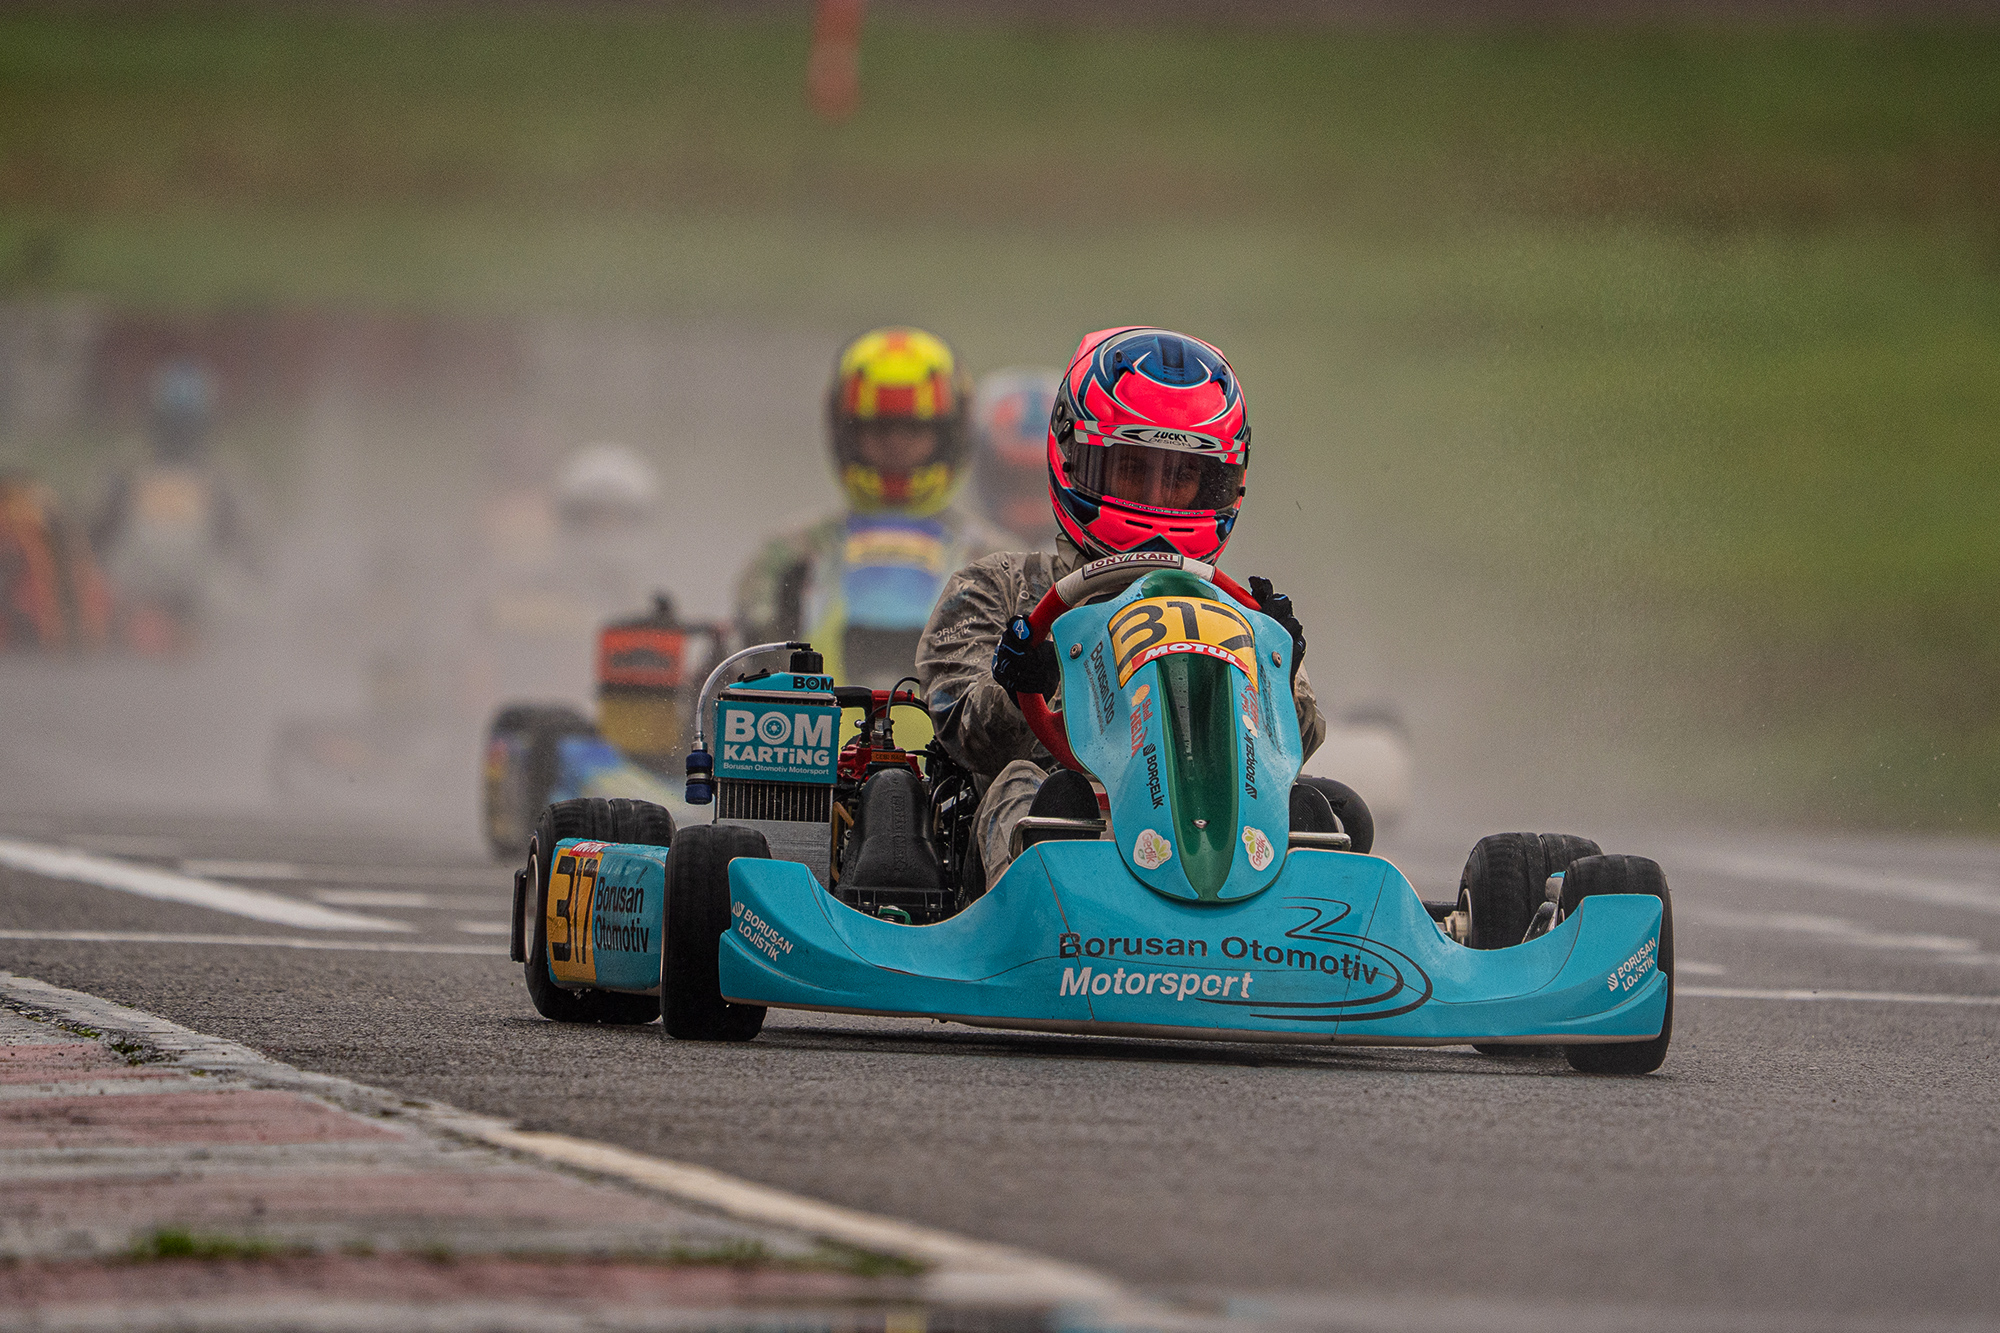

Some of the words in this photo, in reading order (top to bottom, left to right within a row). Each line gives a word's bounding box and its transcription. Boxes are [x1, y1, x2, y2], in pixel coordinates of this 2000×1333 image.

[1149, 438, 1192, 447] DESIGN
[1153, 431, 1188, 442] LUCKY
[935, 615, 977, 639] ORUSAN
[1110, 600, 1255, 676] 317
[1143, 642, 1243, 667] MOTUL
[793, 676, 834, 691] BOM
[724, 709, 833, 748] BOM
[1142, 698, 1153, 722] Shell
[1130, 706, 1148, 758] HELIX
[723, 762, 753, 771] Borusan
[754, 764, 788, 773] Otomotiv
[788, 766, 829, 775] Motorsport
[1146, 754, 1164, 810] BORÇELİK
[1142, 832, 1157, 865] Gedik
[552, 855, 599, 965] 317
[595, 876, 645, 914] Borusan
[594, 914, 650, 954] Otomotiv
[743, 909, 793, 954] BORUSAN
[1059, 932, 1208, 959] Borusan
[1220, 936, 1379, 985] Otomotiv
[1617, 937, 1656, 979] BORUSAN
[1059, 966, 1254, 1001] Motorsport
